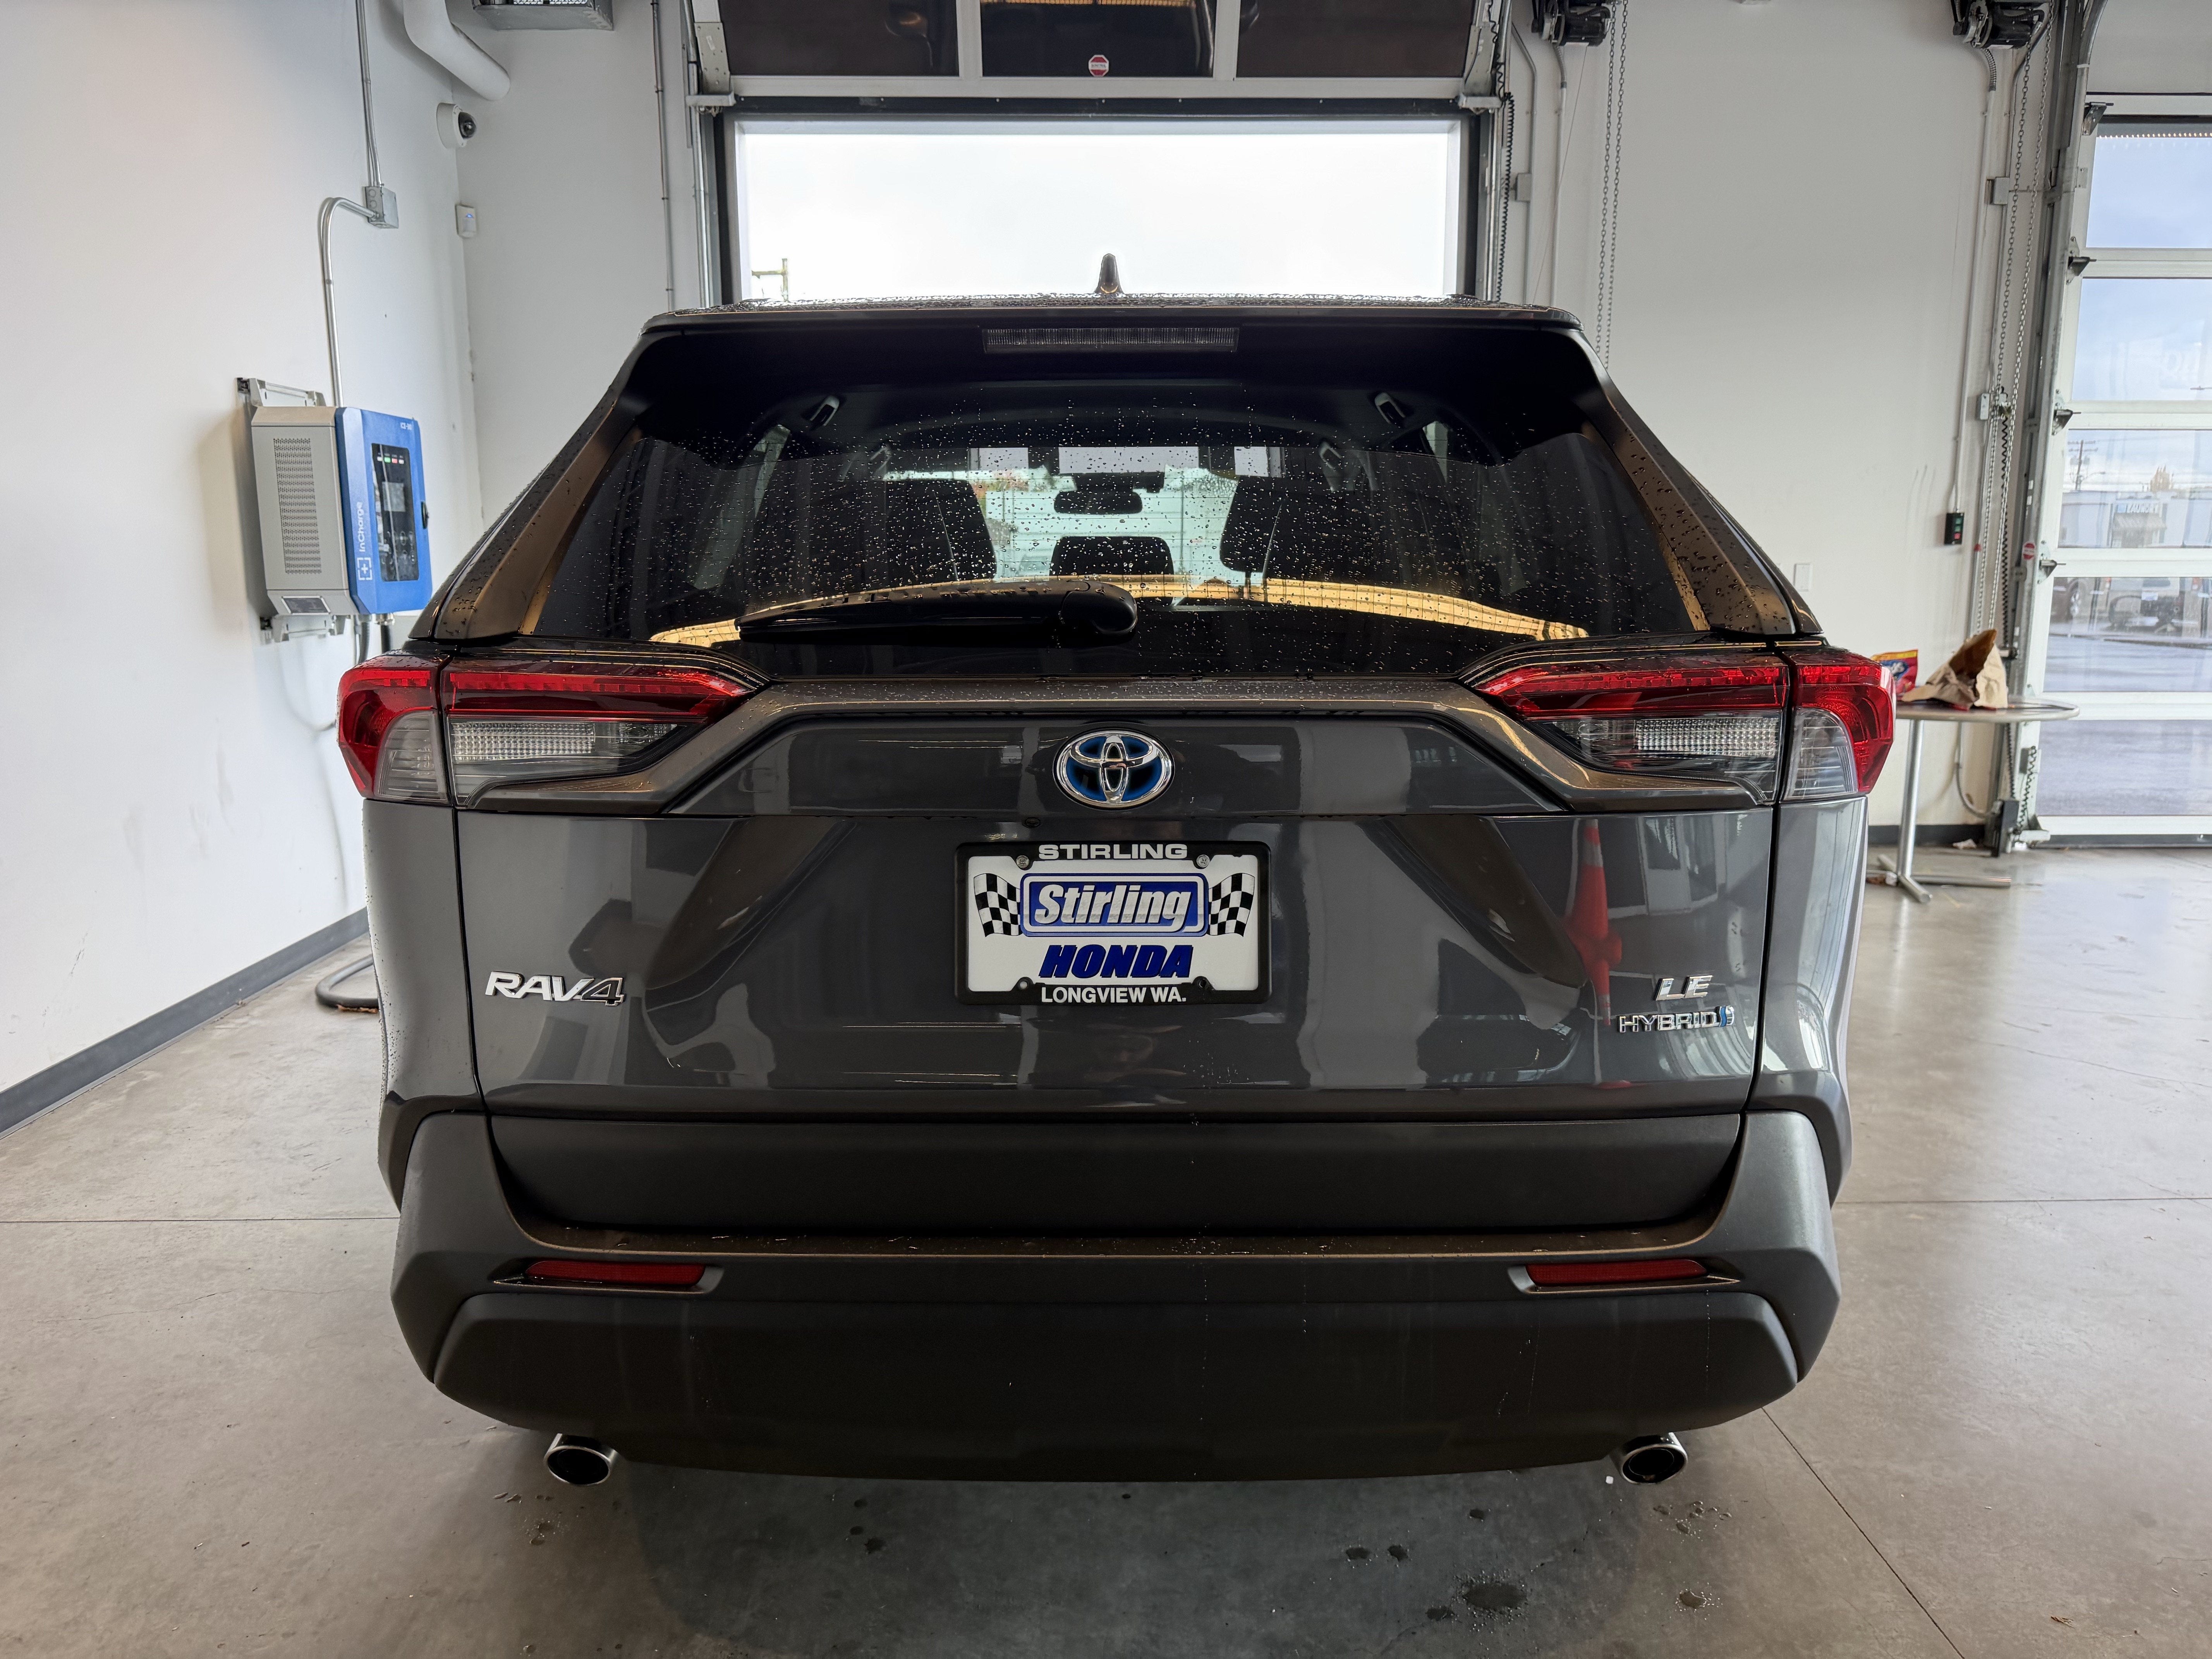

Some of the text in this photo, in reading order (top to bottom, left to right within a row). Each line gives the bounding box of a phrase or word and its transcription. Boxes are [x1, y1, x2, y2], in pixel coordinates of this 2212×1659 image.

[356, 501, 366, 552] InCharge
[1039, 844, 1187, 860] STIRLING
[1034, 884, 1192, 932] Stirling
[1038, 945, 1194, 978] HONDA
[485, 971, 625, 1006] RAV4
[1042, 986, 1187, 1003] LONGVIEW WA.
[1654, 975, 1713, 1001] LE
[1618, 1011, 1719, 1033] HYBRID
